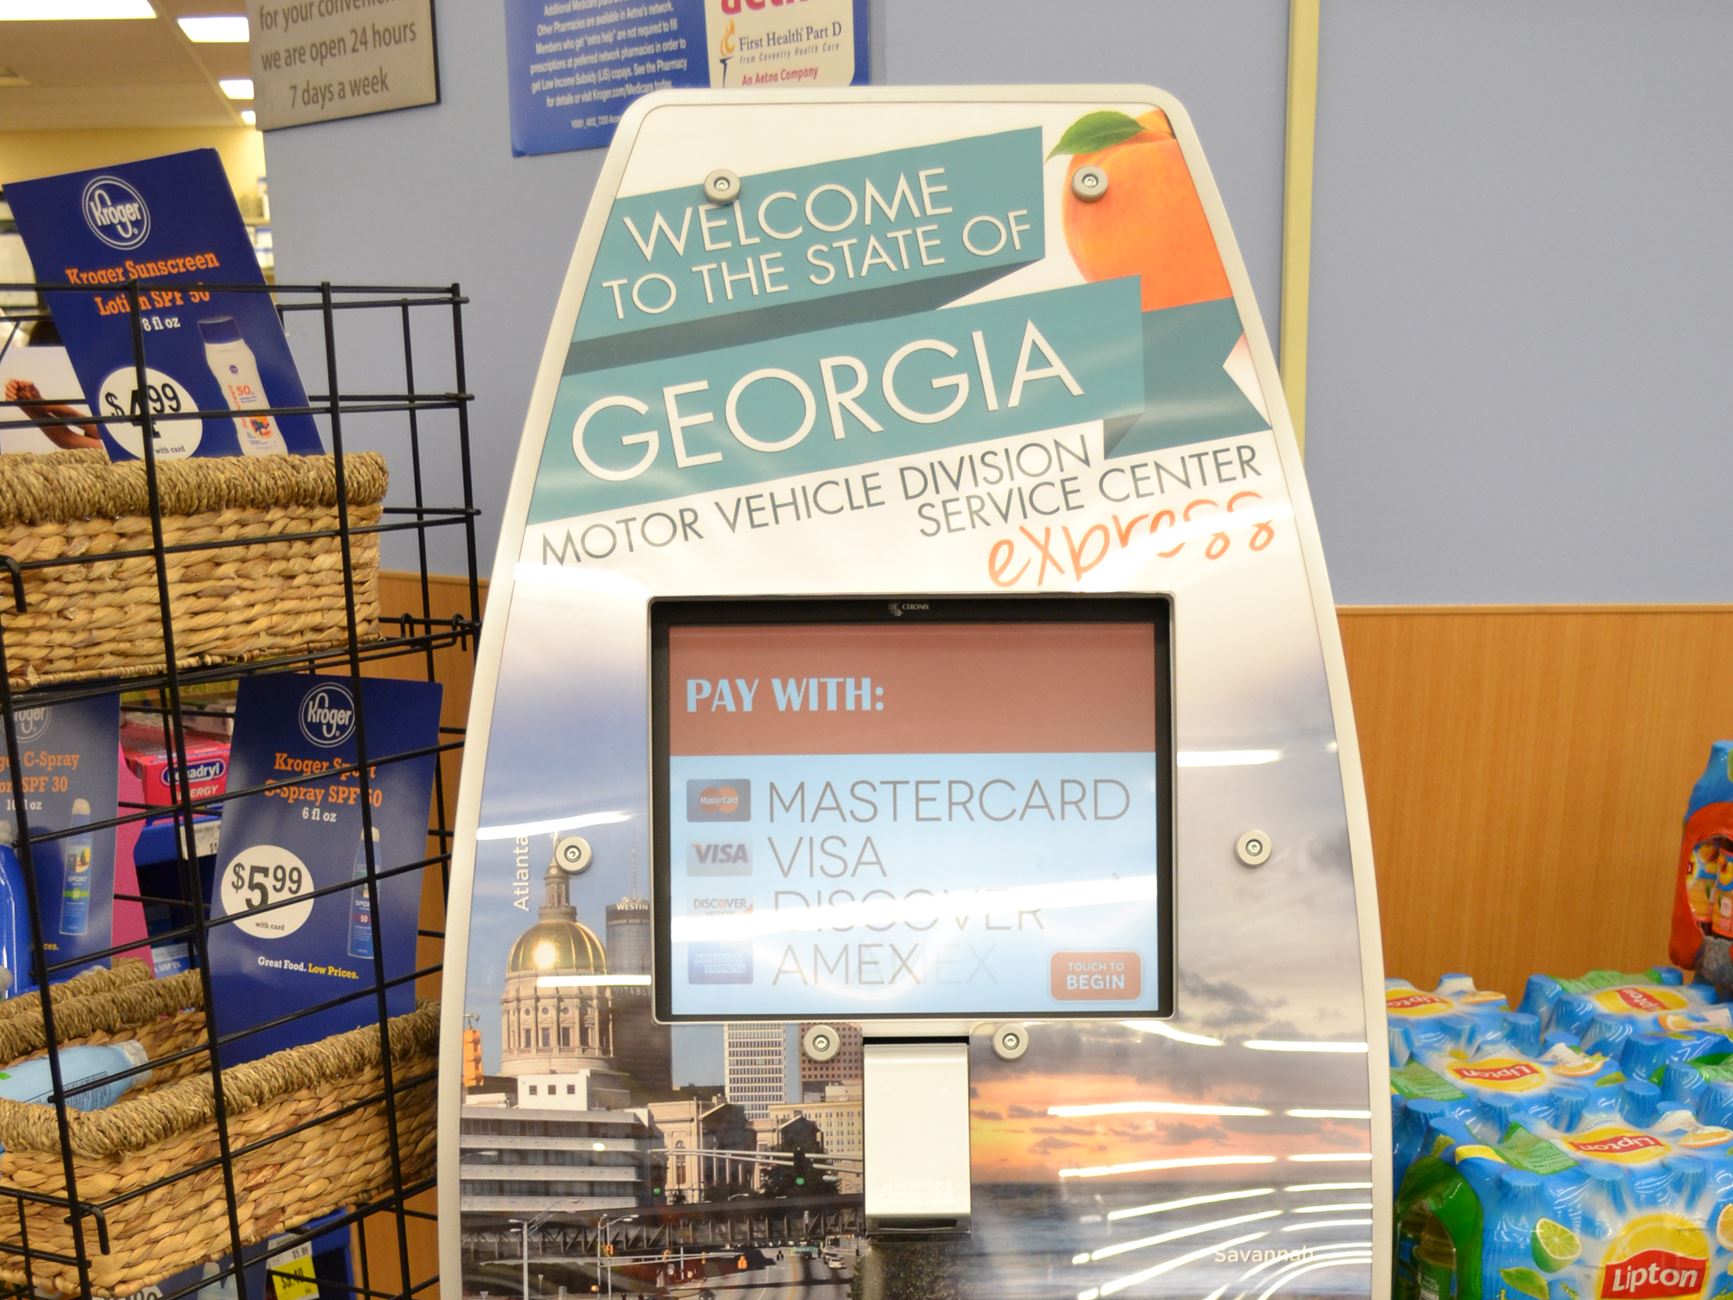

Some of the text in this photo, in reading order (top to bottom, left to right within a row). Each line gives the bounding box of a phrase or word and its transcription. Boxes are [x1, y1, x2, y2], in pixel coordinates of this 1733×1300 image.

[259, 1, 314, 32] for your
[261, 22, 417, 71] we are open 24 hours
[739, 21, 843, 52] First Health Part D
[535, 42, 562, 55] Members
[740, 43, 840, 65] from Coventry Health Care
[530, 57, 566, 76] prescriptions
[656, 58, 688, 73] Pharmacy
[742, 66, 819, 86] An Aetna Company
[290, 66, 389, 110] 7 days a week
[89, 189, 141, 239] Kroger
[623, 167, 952, 262] WELCOME
[65, 251, 220, 286] Kroger Sunscreen
[602, 209, 1031, 320] TO THE STATE OF
[94, 291, 152, 316] Lotin
[142, 316, 181, 332] 8 fl oz
[571, 318, 1085, 481] GEORGIA
[155, 445, 186, 455] with card
[541, 434, 1091, 566] MOTOR VEHICLE DIVISION
[918, 445, 1263, 538] SERVICE CENTER
[686, 677, 885, 712] PAY WITH:
[306, 692, 352, 737] Kroger
[23, 751, 80, 771] C-Spray
[274, 752, 329, 776] Kroger
[22, 776, 49, 793] SPF
[52, 776, 68, 793] 30
[328, 785, 361, 805] SPF
[30, 801, 42, 810] oz
[699, 795, 739, 805] MasterCard
[768, 778, 1131, 823] MASTERCARD
[302, 807, 337, 823] 6 fl oz
[692, 843, 749, 863] VISA
[767, 835, 887, 878] VISA
[512, 834, 530, 912] Atlanta
[616, 903, 649, 911] WESTIN
[693, 898, 747, 909] DISCOVER
[256, 922, 285, 931] with card
[257, 956, 359, 980] Great Food. Low Prices.
[772, 943, 921, 986] AMEX
[1068, 961, 1125, 972] TOUCH TO
[1066, 974, 1126, 990] BEGIN
[1462, 1063, 1533, 1079] Lipton
[1580, 1135, 1658, 1151] Lipton
[1214, 1244, 1316, 1264] Savannah
[1611, 1262, 1698, 1293] Lipton
